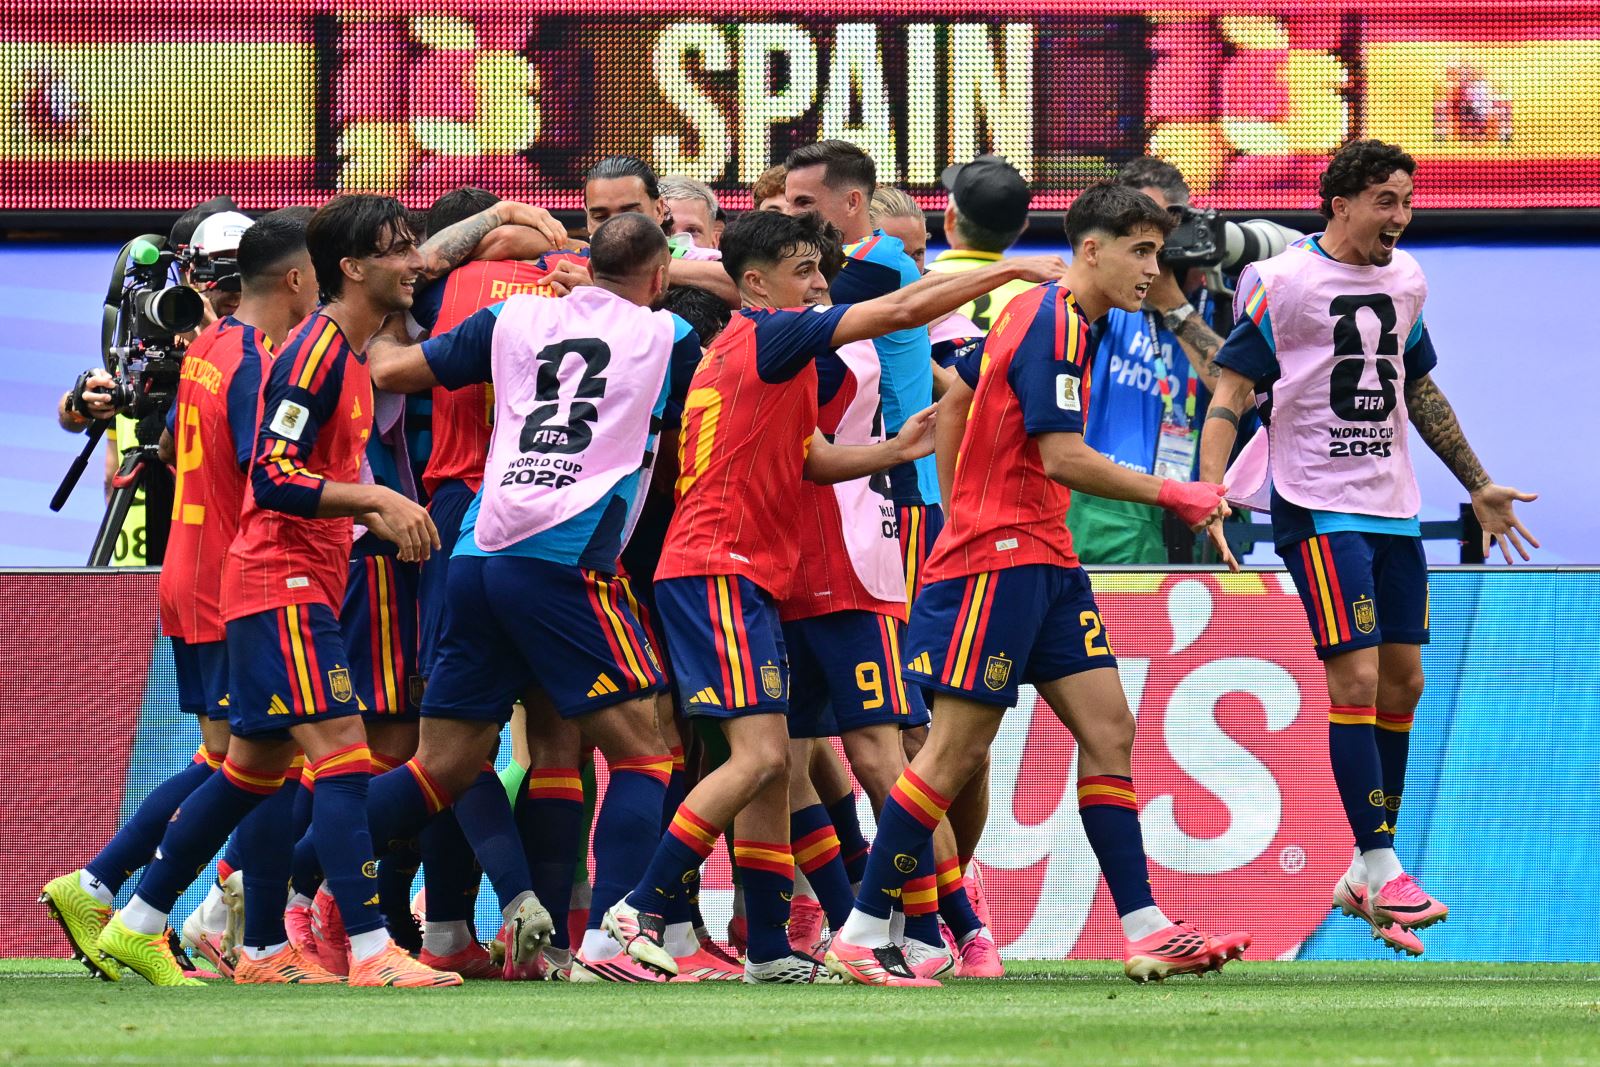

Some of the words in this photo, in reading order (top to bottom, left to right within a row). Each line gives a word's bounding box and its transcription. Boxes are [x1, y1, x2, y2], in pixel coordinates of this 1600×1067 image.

[652, 22, 1033, 184] SPAIN
[1354, 396, 1385, 410] FIFA
[532, 429, 569, 446] FIFA
[1329, 427, 1377, 439] WORLD
[508, 457, 551, 470] WORLD
[553, 459, 583, 475] CUP
[1079, 610, 1114, 658] 2
[855, 661, 884, 710] 9
